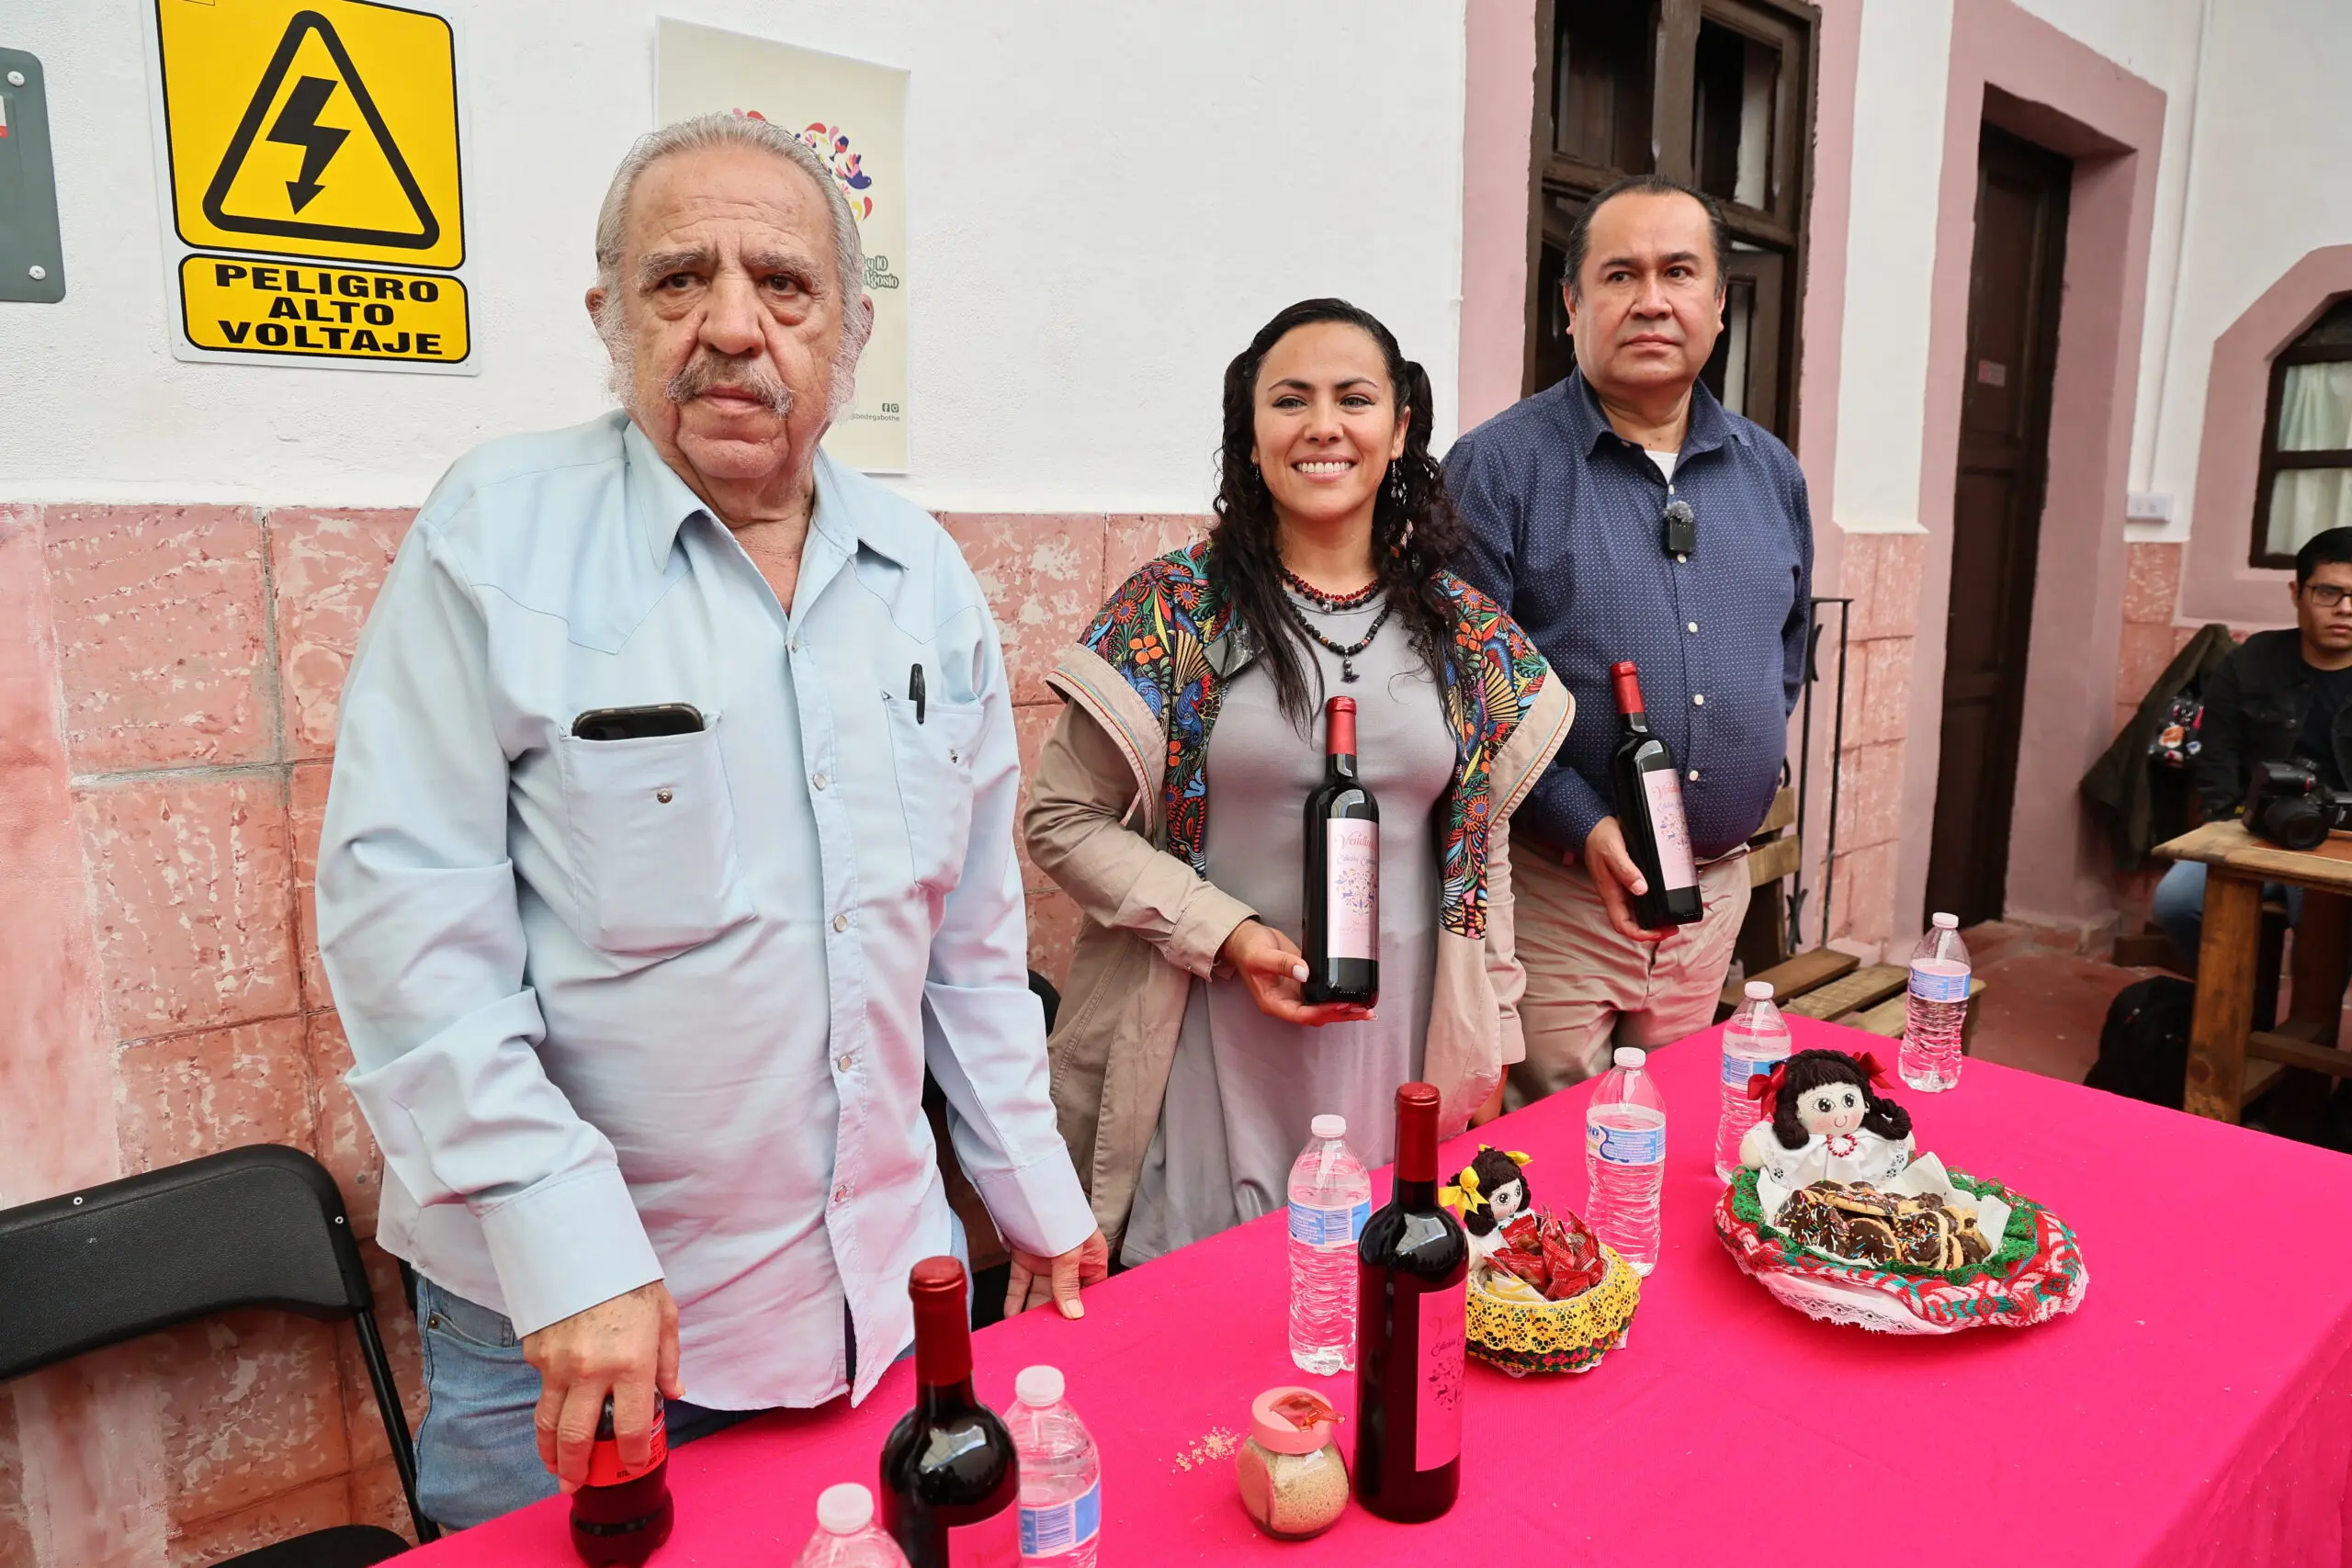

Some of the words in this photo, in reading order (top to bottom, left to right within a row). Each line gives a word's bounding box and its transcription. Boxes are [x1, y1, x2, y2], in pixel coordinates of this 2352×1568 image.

[875, 255, 888, 271] 10
[215, 264, 439, 302] PELIGRO
[268, 297, 394, 326] ALTO
[218, 321, 442, 355] VOLTAJE
